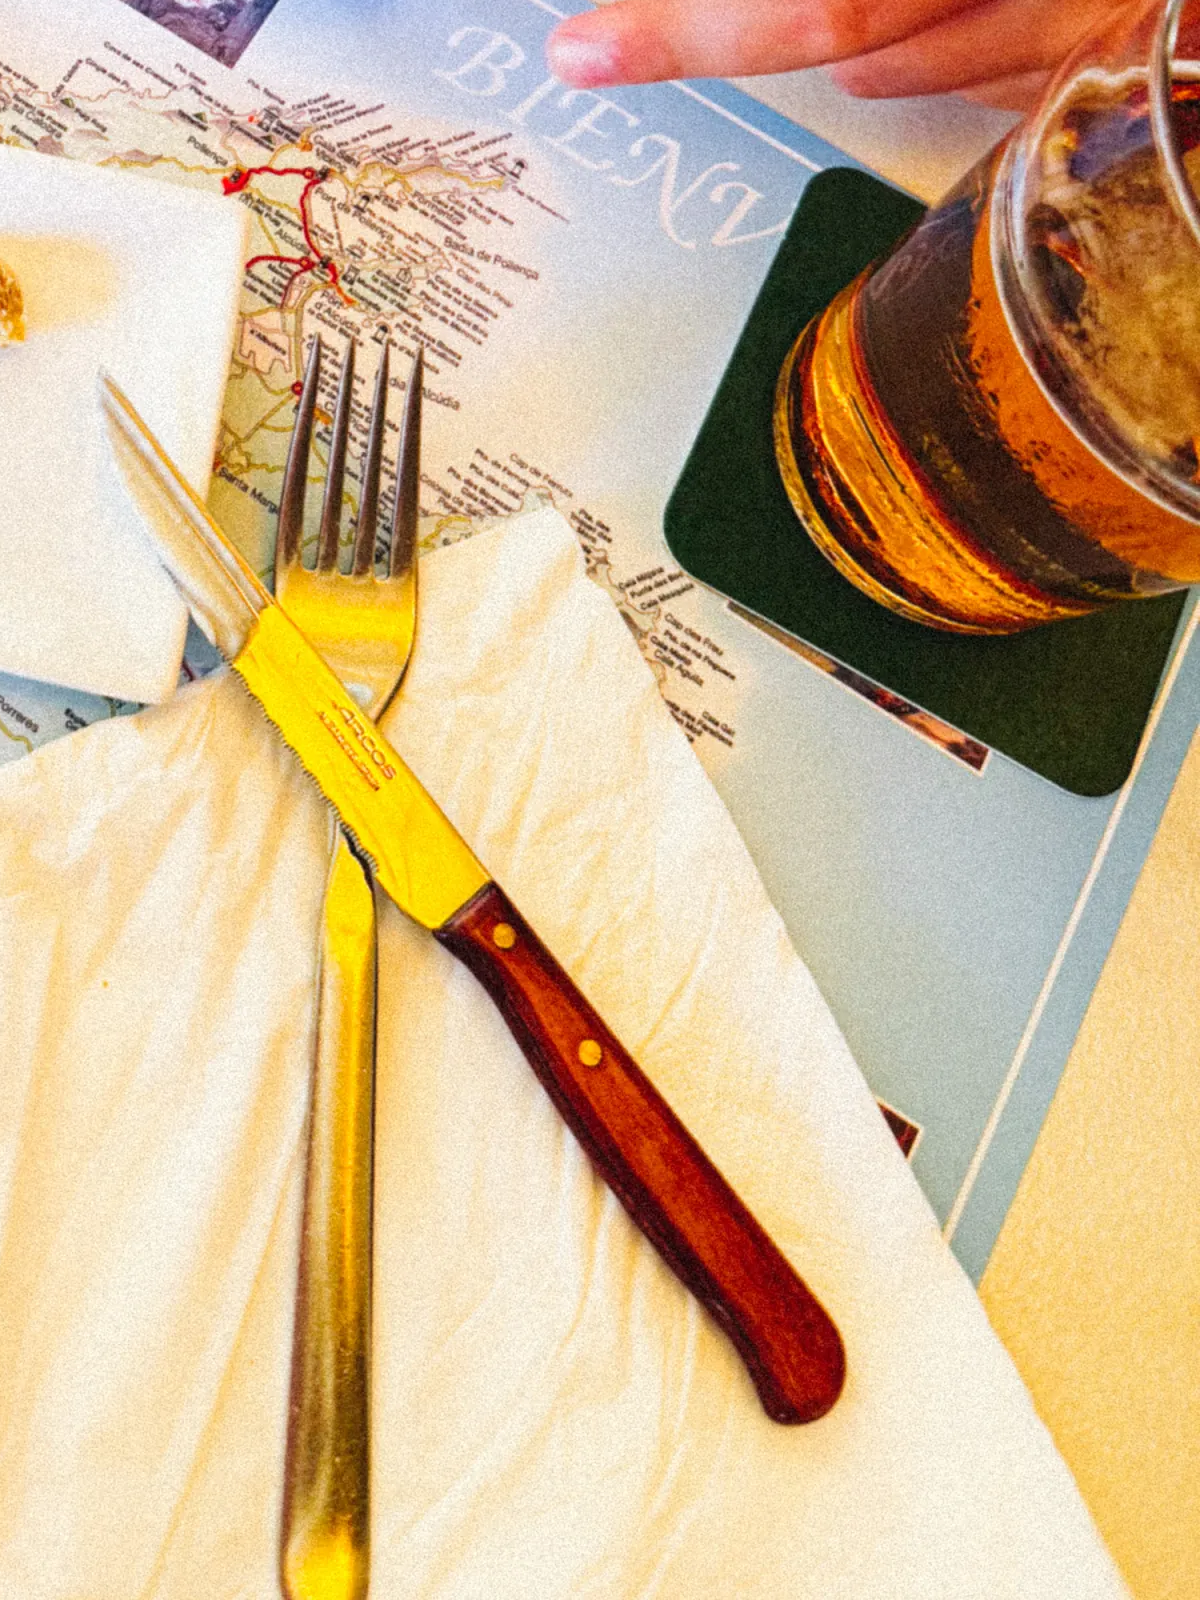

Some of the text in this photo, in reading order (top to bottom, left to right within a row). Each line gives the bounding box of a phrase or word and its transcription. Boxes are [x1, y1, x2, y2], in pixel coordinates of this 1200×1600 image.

[186, 134, 229, 167] Pollença
[314, 186, 337, 202] Port
[443, 234, 475, 258] Badia
[476, 249, 492, 263] de
[492, 253, 540, 281] Pollença
[509, 452, 530, 470] Cap
[528, 465, 543, 479] de
[217, 467, 250, 495] Santa
[664, 611, 684, 631] Cap
[654, 648, 675, 669] Cala
